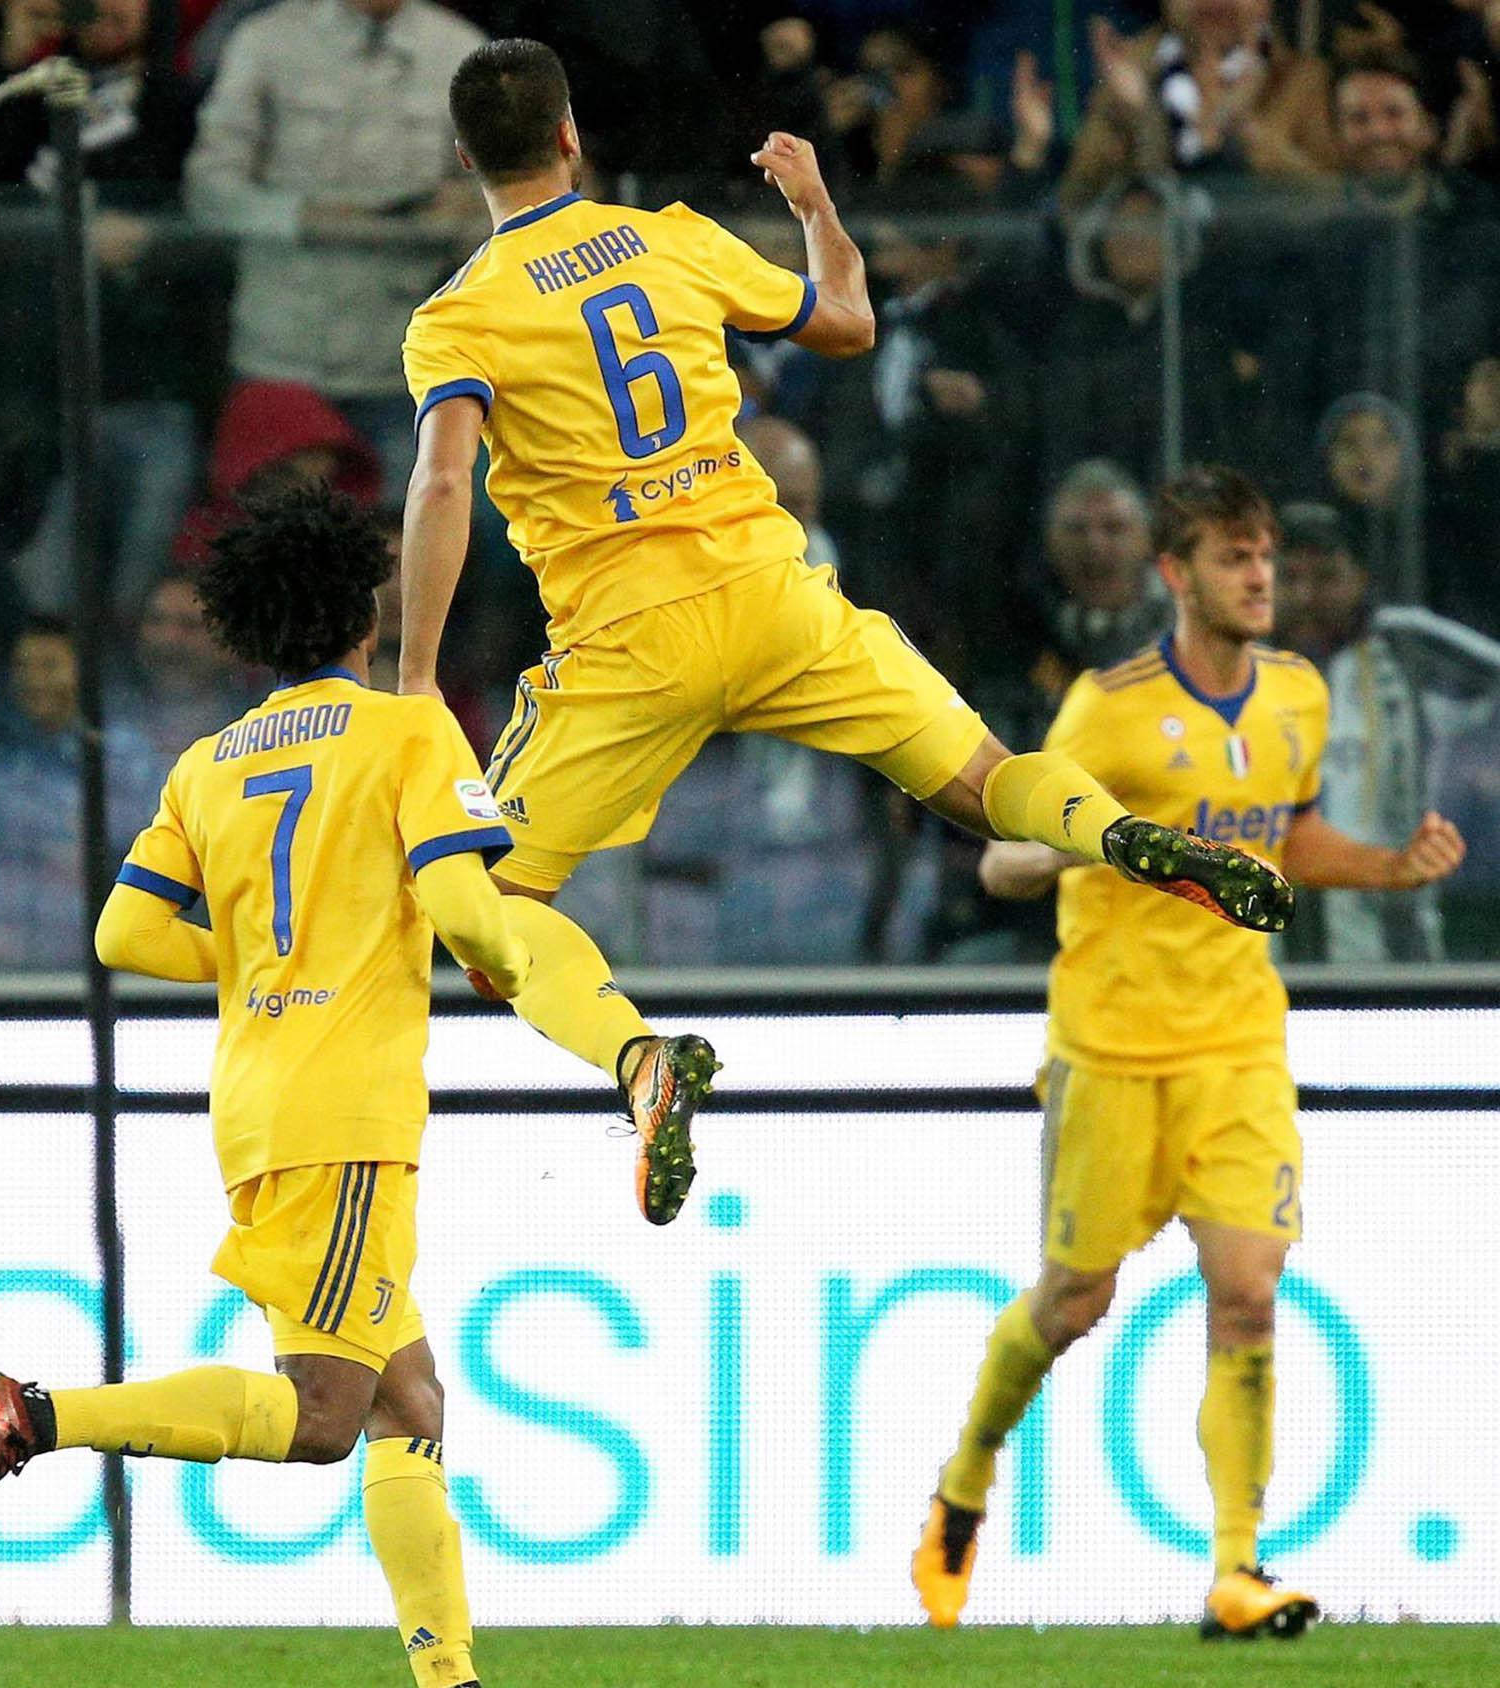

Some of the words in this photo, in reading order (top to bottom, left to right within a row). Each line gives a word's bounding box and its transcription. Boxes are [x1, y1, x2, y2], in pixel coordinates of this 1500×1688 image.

[523, 224, 649, 295] KHEDIRA
[581, 283, 687, 459] 6
[213, 703, 353, 762] CUADRADO
[242, 763, 313, 957] 7
